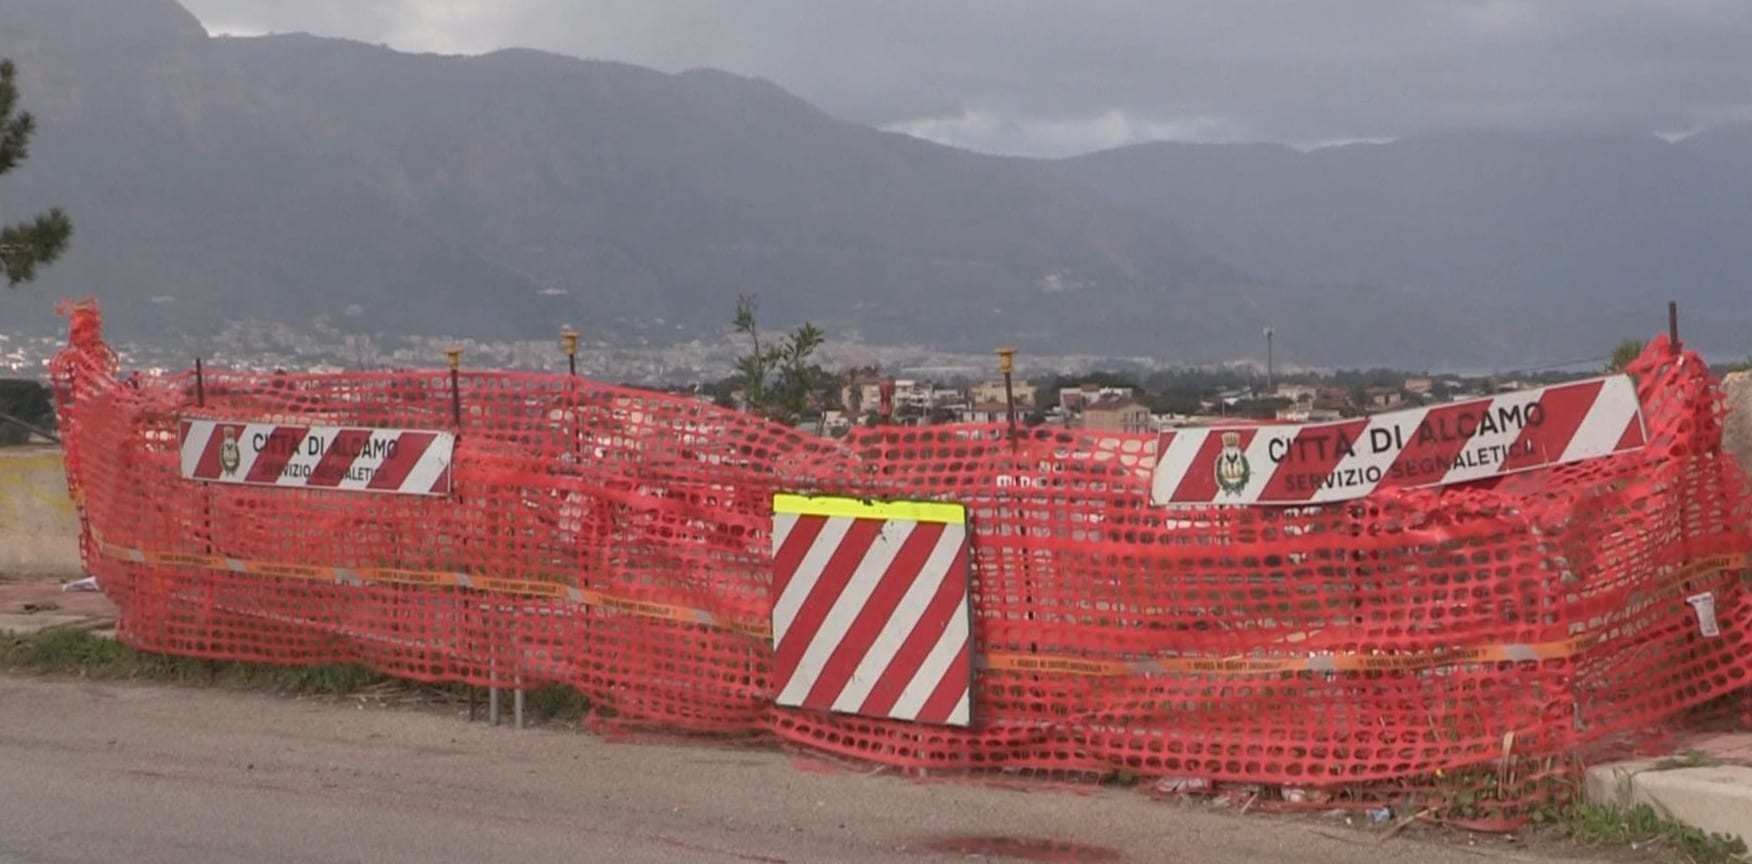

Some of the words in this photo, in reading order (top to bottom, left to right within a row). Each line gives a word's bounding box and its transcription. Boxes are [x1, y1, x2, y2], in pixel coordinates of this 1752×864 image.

[308, 435, 325, 457] DI
[330, 436, 398, 460] ALCAMO
[1268, 430, 1356, 464] CITTÀ
[1370, 424, 1403, 454] DI
[1416, 401, 1545, 447] ALCAMO
[1284, 464, 1382, 492] SERVIZIO
[1391, 438, 1535, 481] SEGNALETICA
